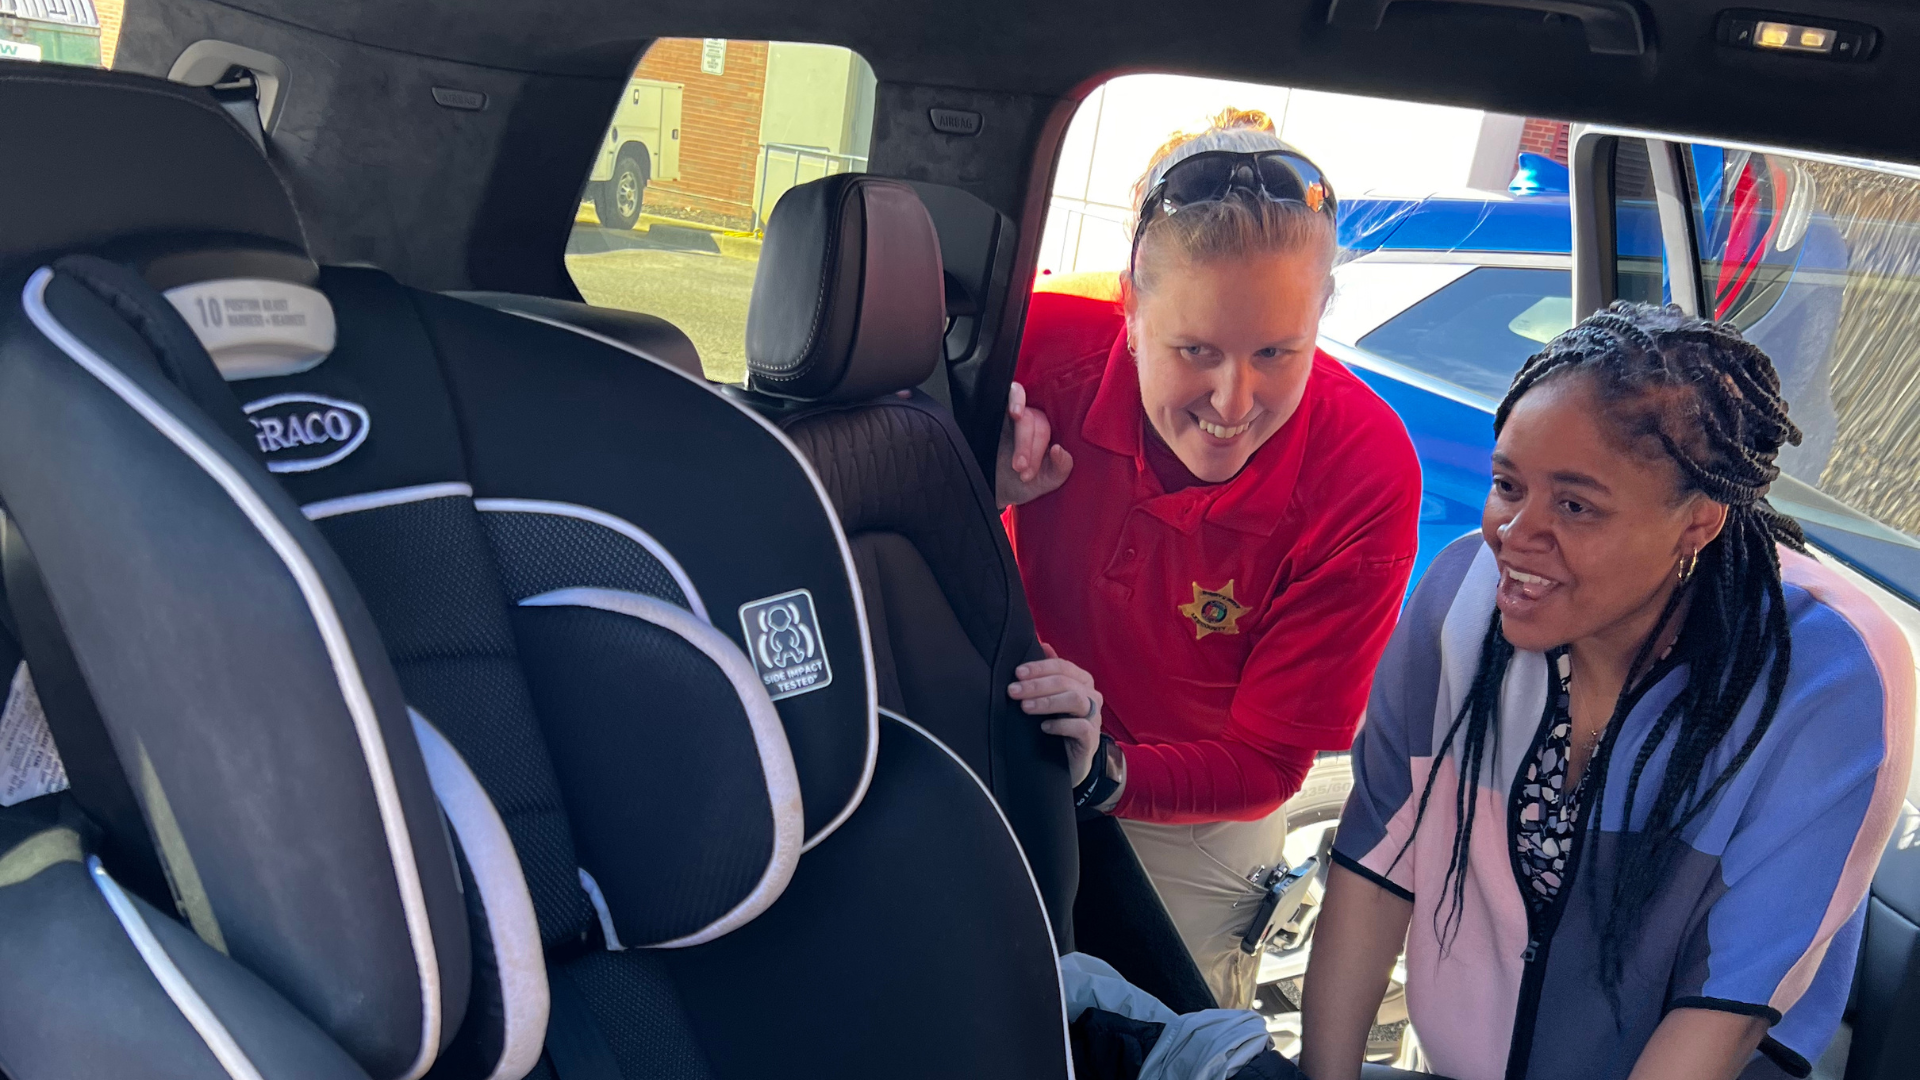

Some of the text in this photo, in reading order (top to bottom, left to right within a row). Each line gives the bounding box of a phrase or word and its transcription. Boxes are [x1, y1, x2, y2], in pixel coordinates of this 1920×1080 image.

[940, 115, 973, 129] AIRBAG
[196, 297, 223, 328] 10
[763, 660, 823, 685] SIDE IMPACT
[1300, 782, 1352, 800] 235/60
